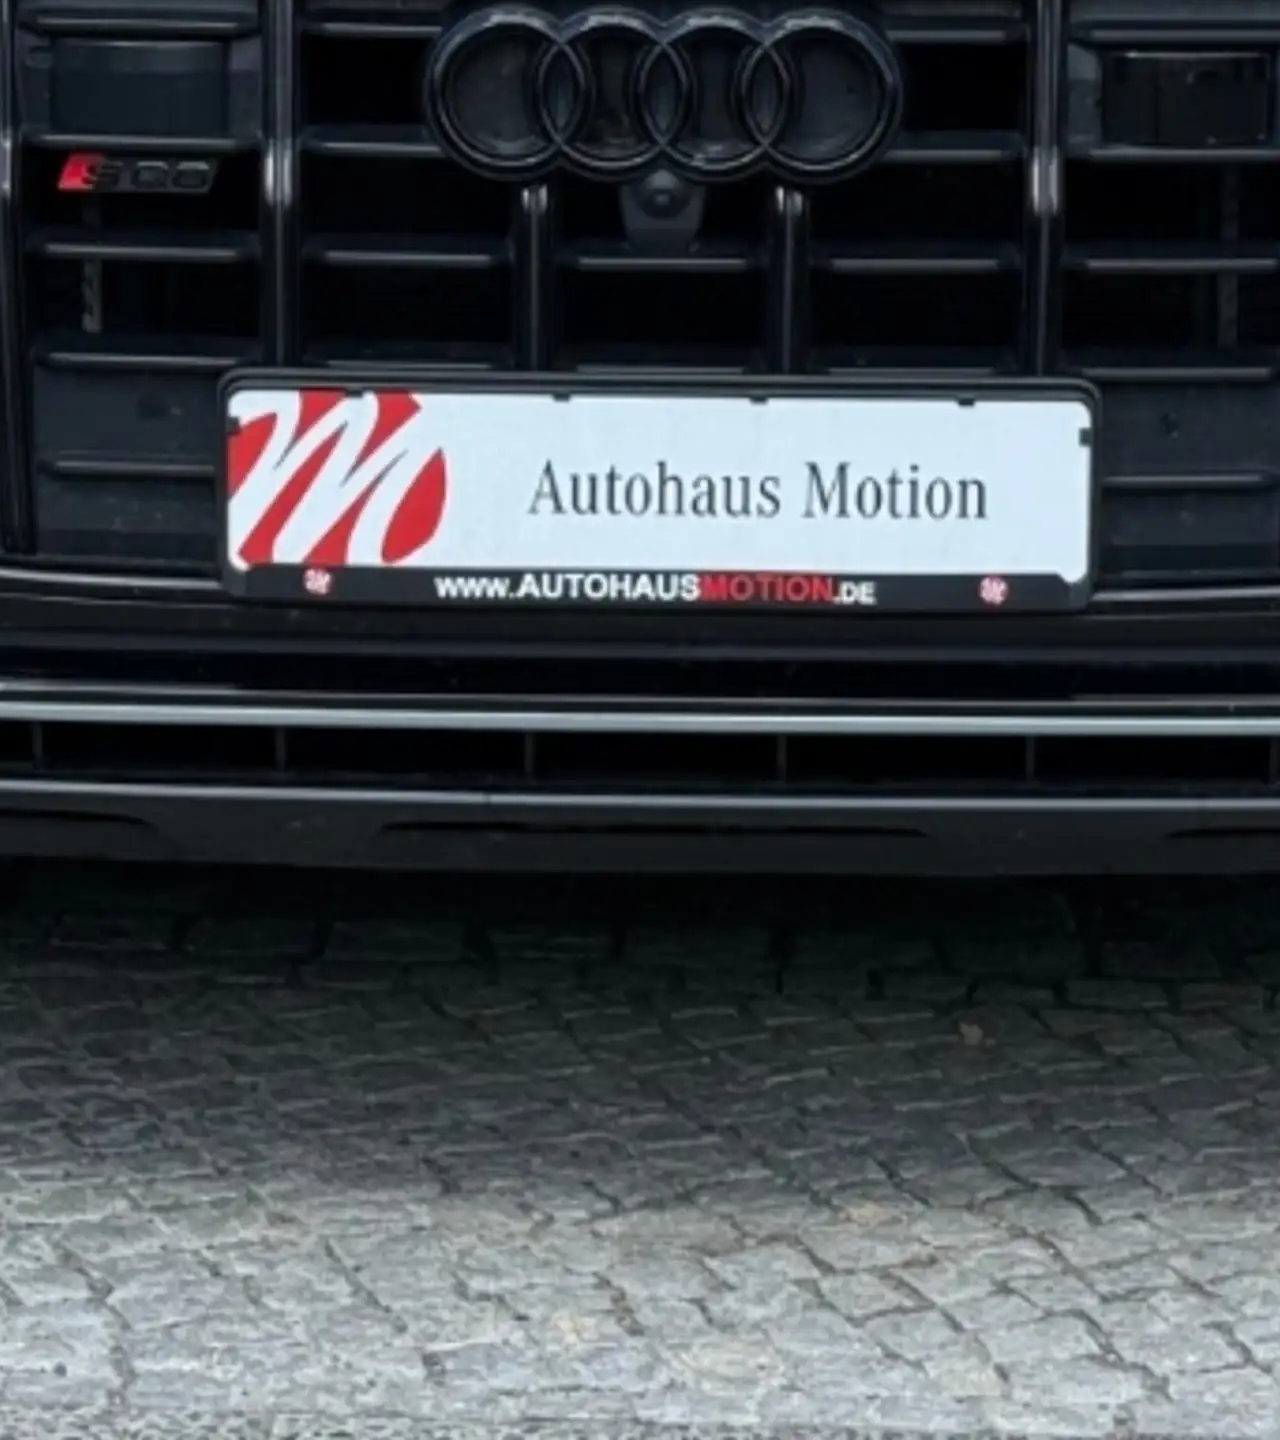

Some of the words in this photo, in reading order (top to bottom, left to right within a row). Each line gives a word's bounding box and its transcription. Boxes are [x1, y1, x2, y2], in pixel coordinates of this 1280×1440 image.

[527, 457, 781, 519] Autohaus
[801, 460, 988, 520] Motion
[433, 572, 877, 605] www.AUTOHAUSMOTION.DE
